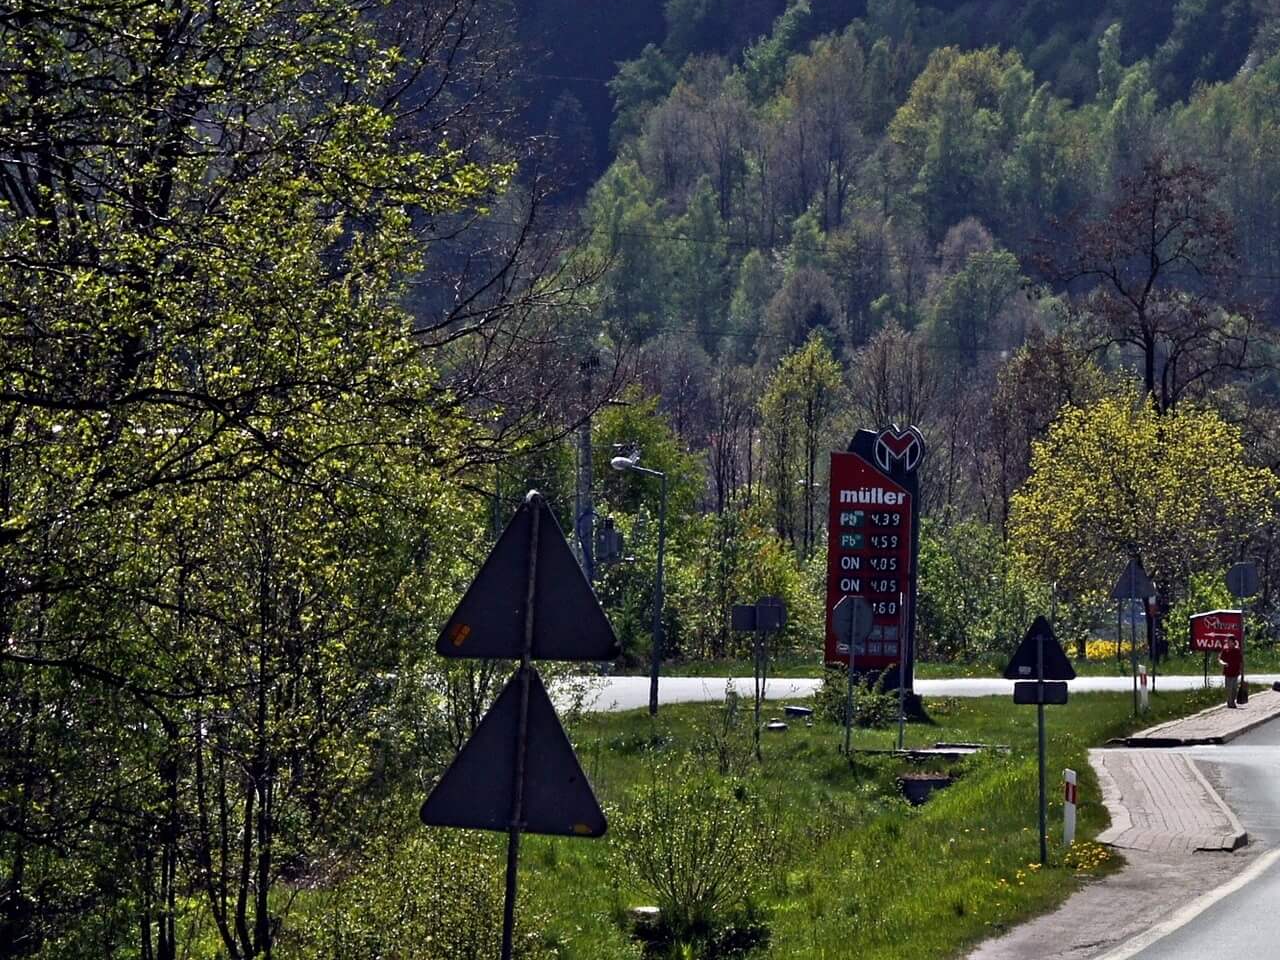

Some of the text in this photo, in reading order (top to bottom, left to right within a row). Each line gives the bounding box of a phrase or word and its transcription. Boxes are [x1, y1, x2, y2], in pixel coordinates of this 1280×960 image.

[839, 486, 906, 504] müller
[871, 513, 900, 526] 4.39
[841, 556, 897, 571] ON 4.05
[840, 579, 897, 593] ON 4.05
